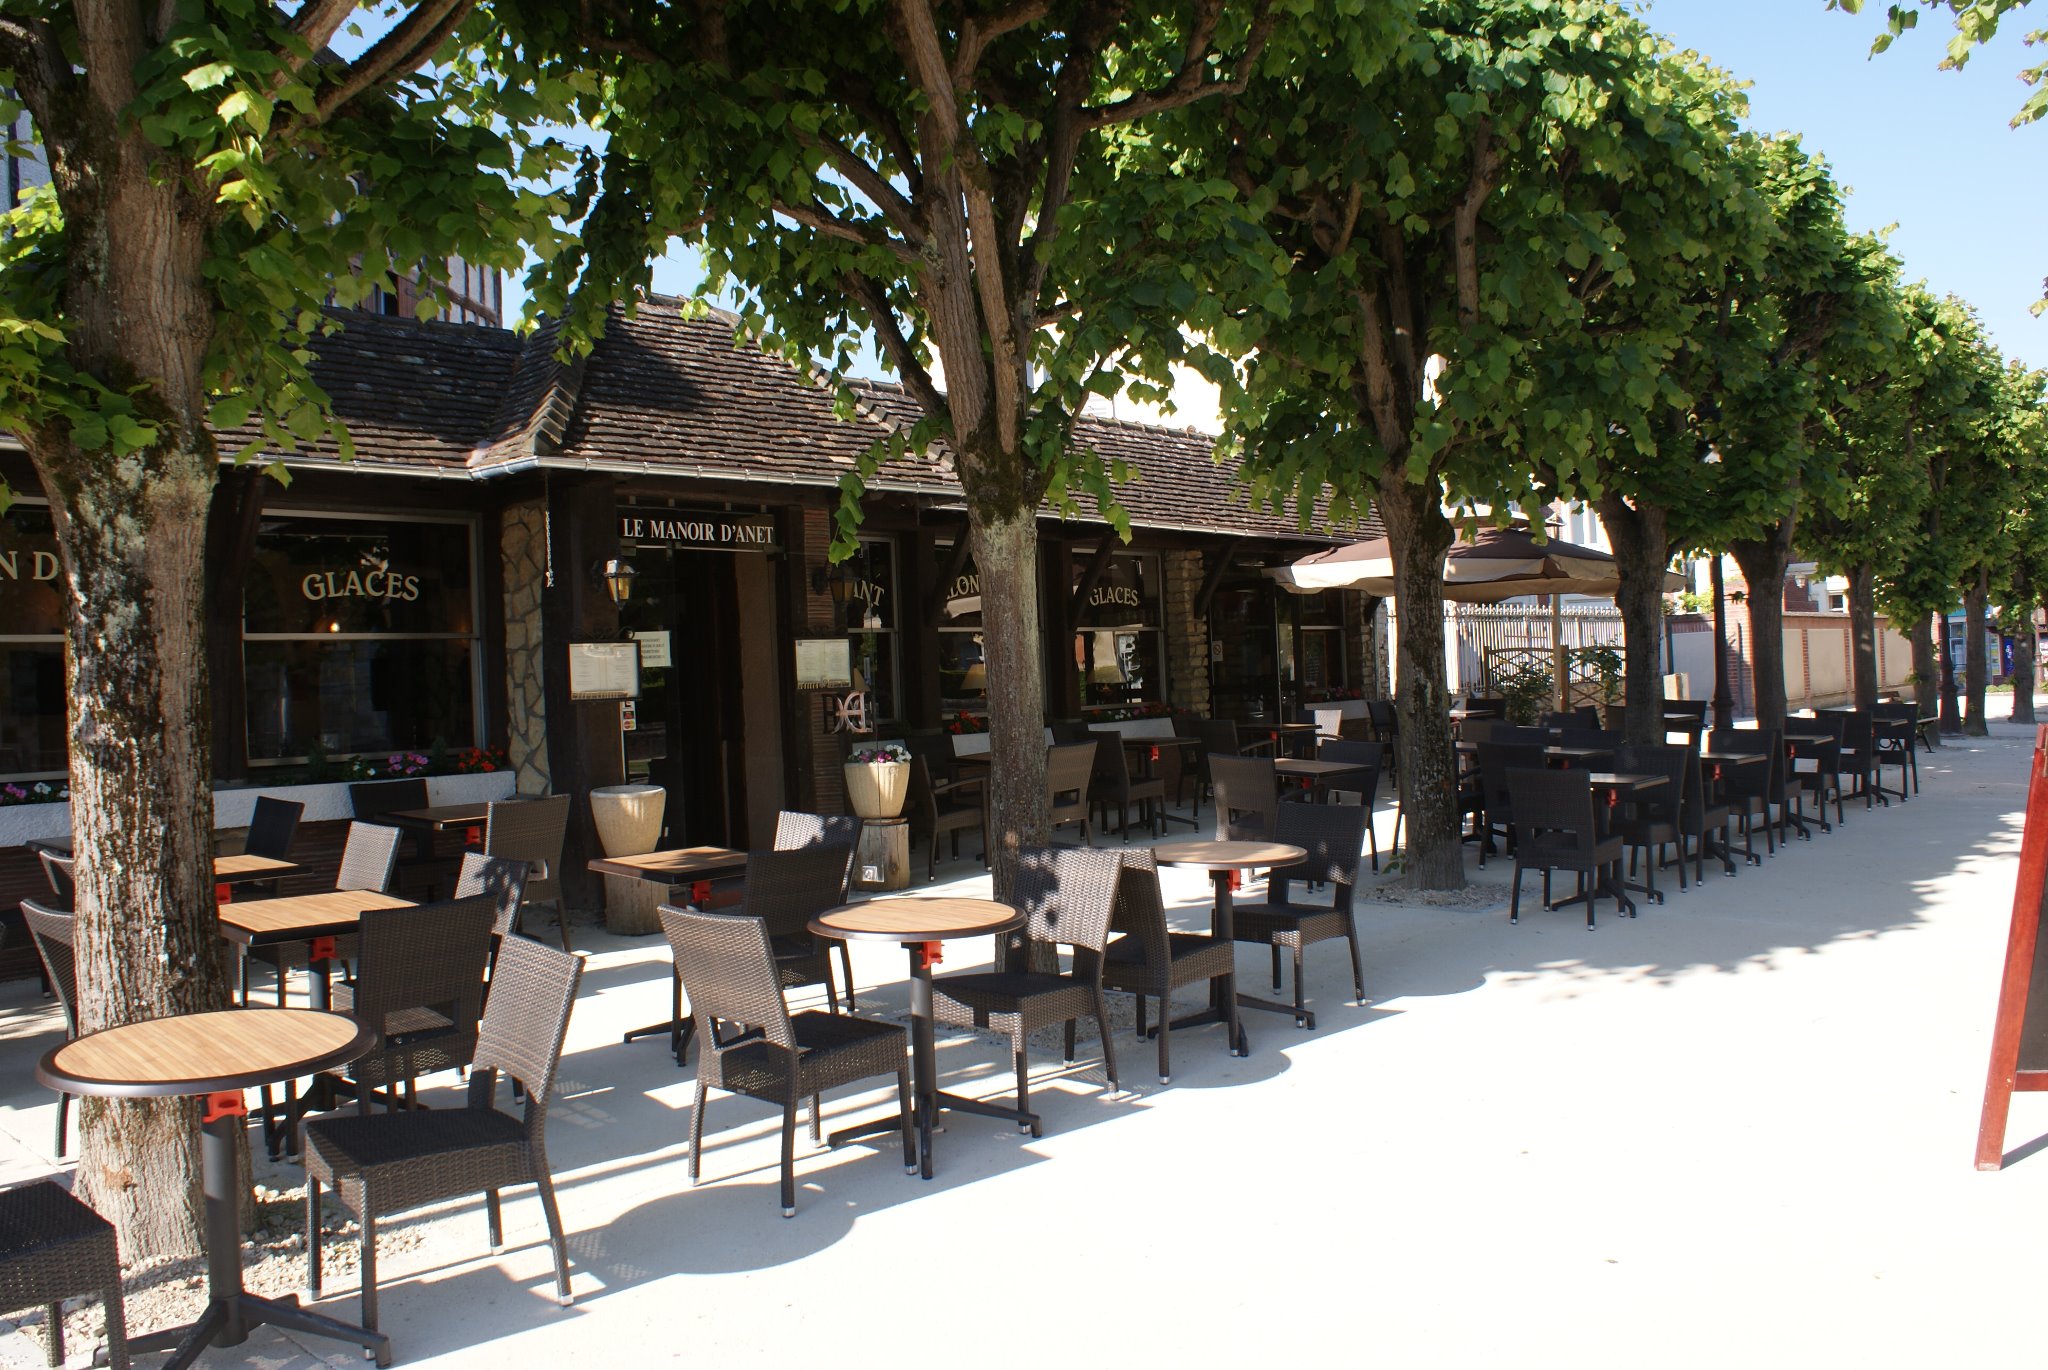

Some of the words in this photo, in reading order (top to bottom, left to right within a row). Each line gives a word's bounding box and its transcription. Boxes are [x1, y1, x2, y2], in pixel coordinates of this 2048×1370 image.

[623, 518, 644, 538] LE
[650, 520, 715, 541] MANOIR
[721, 524, 774, 544] D'ANET
[302, 570, 420, 601] GLACES
[946, 574, 980, 600] LON
[1089, 586, 1139, 607] GLACES
